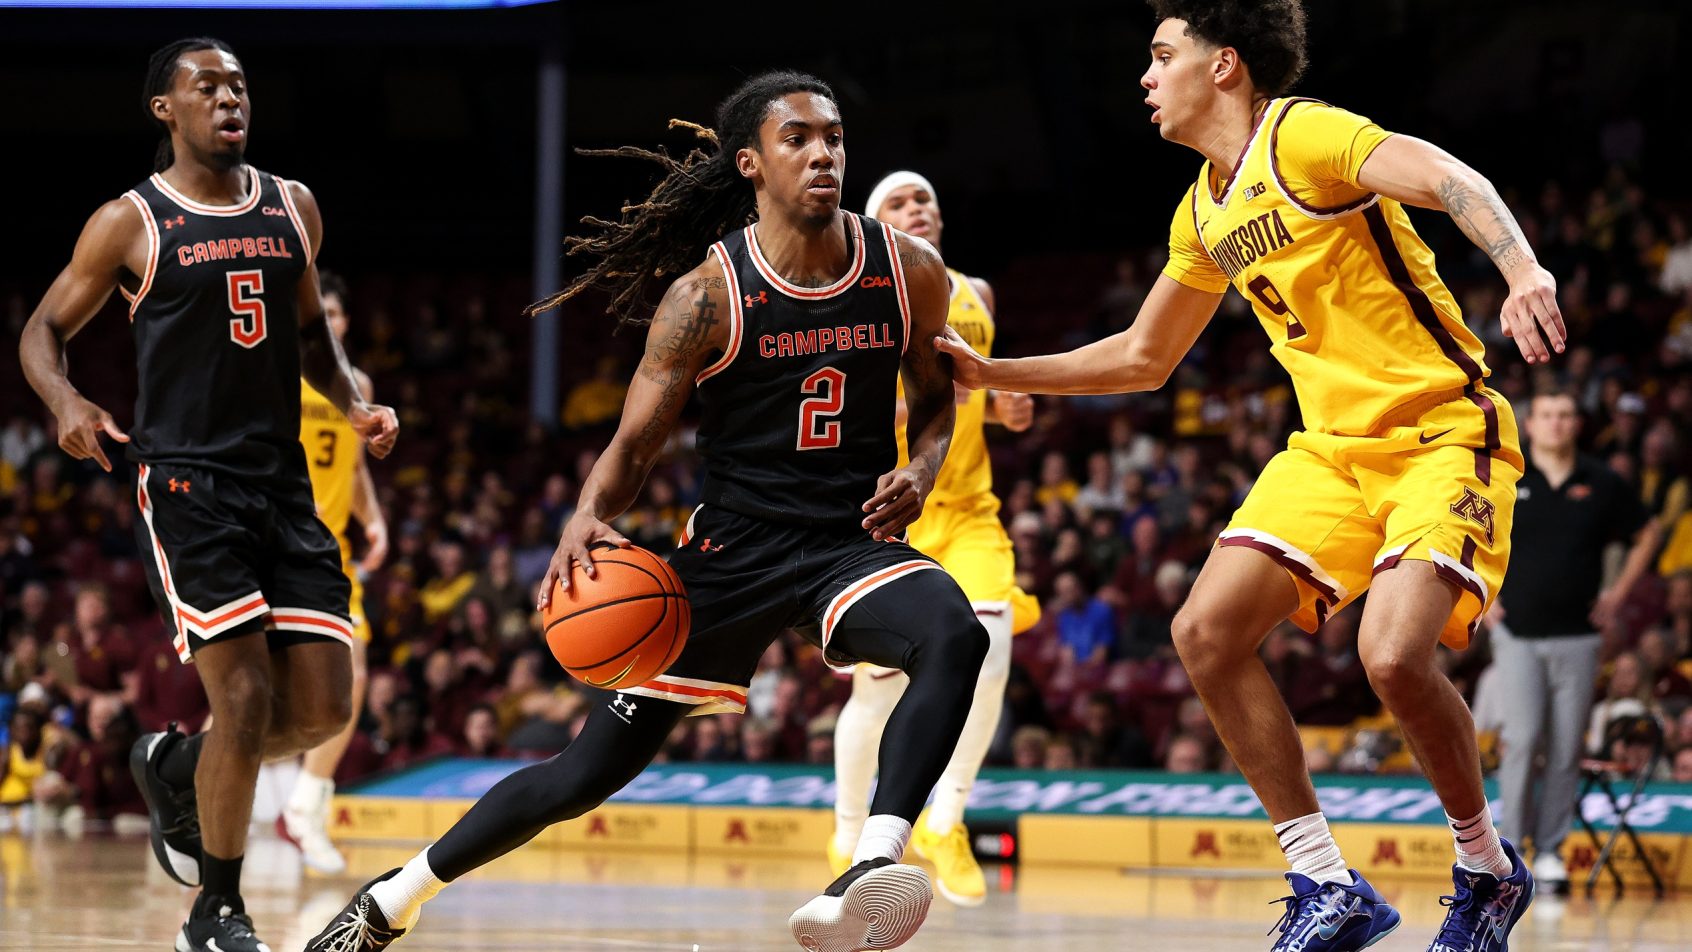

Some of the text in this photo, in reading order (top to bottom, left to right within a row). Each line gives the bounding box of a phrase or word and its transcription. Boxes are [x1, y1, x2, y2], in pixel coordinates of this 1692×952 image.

[262, 205, 287, 217] CAA
[177, 236, 293, 267] CAMPBELL
[860, 275, 892, 289] CAA
[225, 269, 268, 349] 5
[1247, 274, 1308, 341] 9
[759, 323, 895, 359] CAMPBELL
[796, 366, 847, 452] 2
[315, 428, 338, 469] 3
